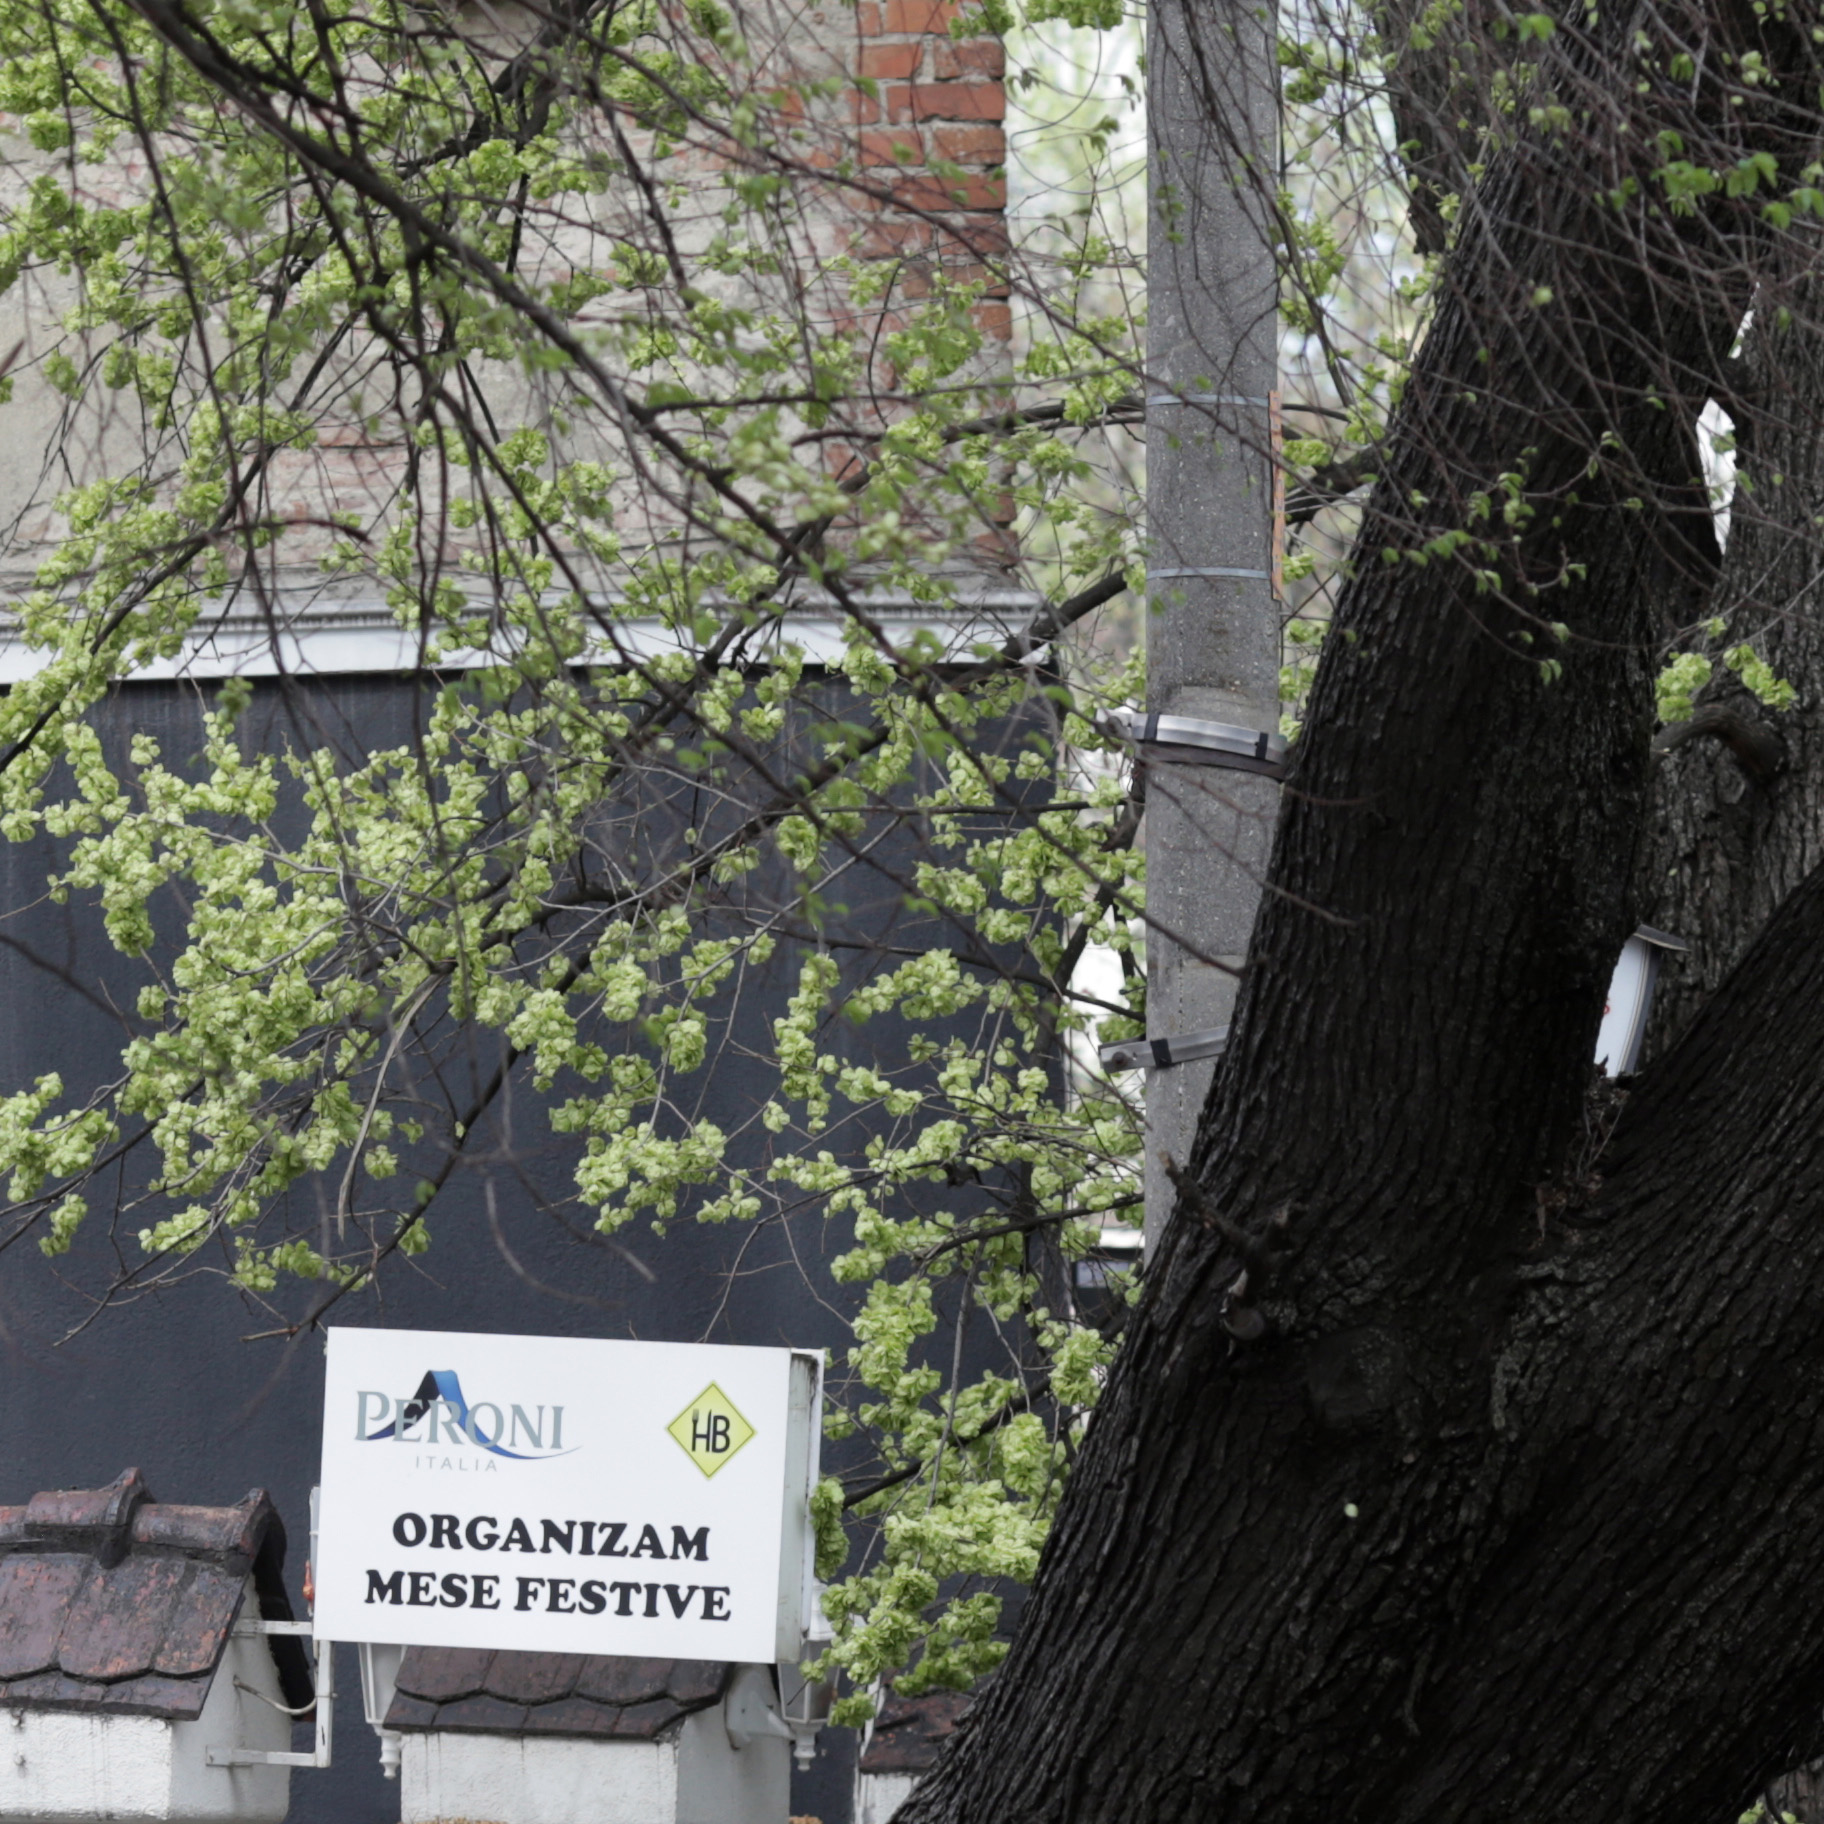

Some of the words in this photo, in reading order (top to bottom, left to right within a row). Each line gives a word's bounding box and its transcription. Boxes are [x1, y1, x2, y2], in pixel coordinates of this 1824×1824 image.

[354, 1391, 566, 1450] PERONI
[691, 1407, 731, 1454] HB
[415, 1456, 498, 1473] ITALIA
[392, 1512, 712, 1563] ORGANIZAM
[365, 1570, 501, 1611] MESE
[514, 1577, 732, 1622] FESTIVE
